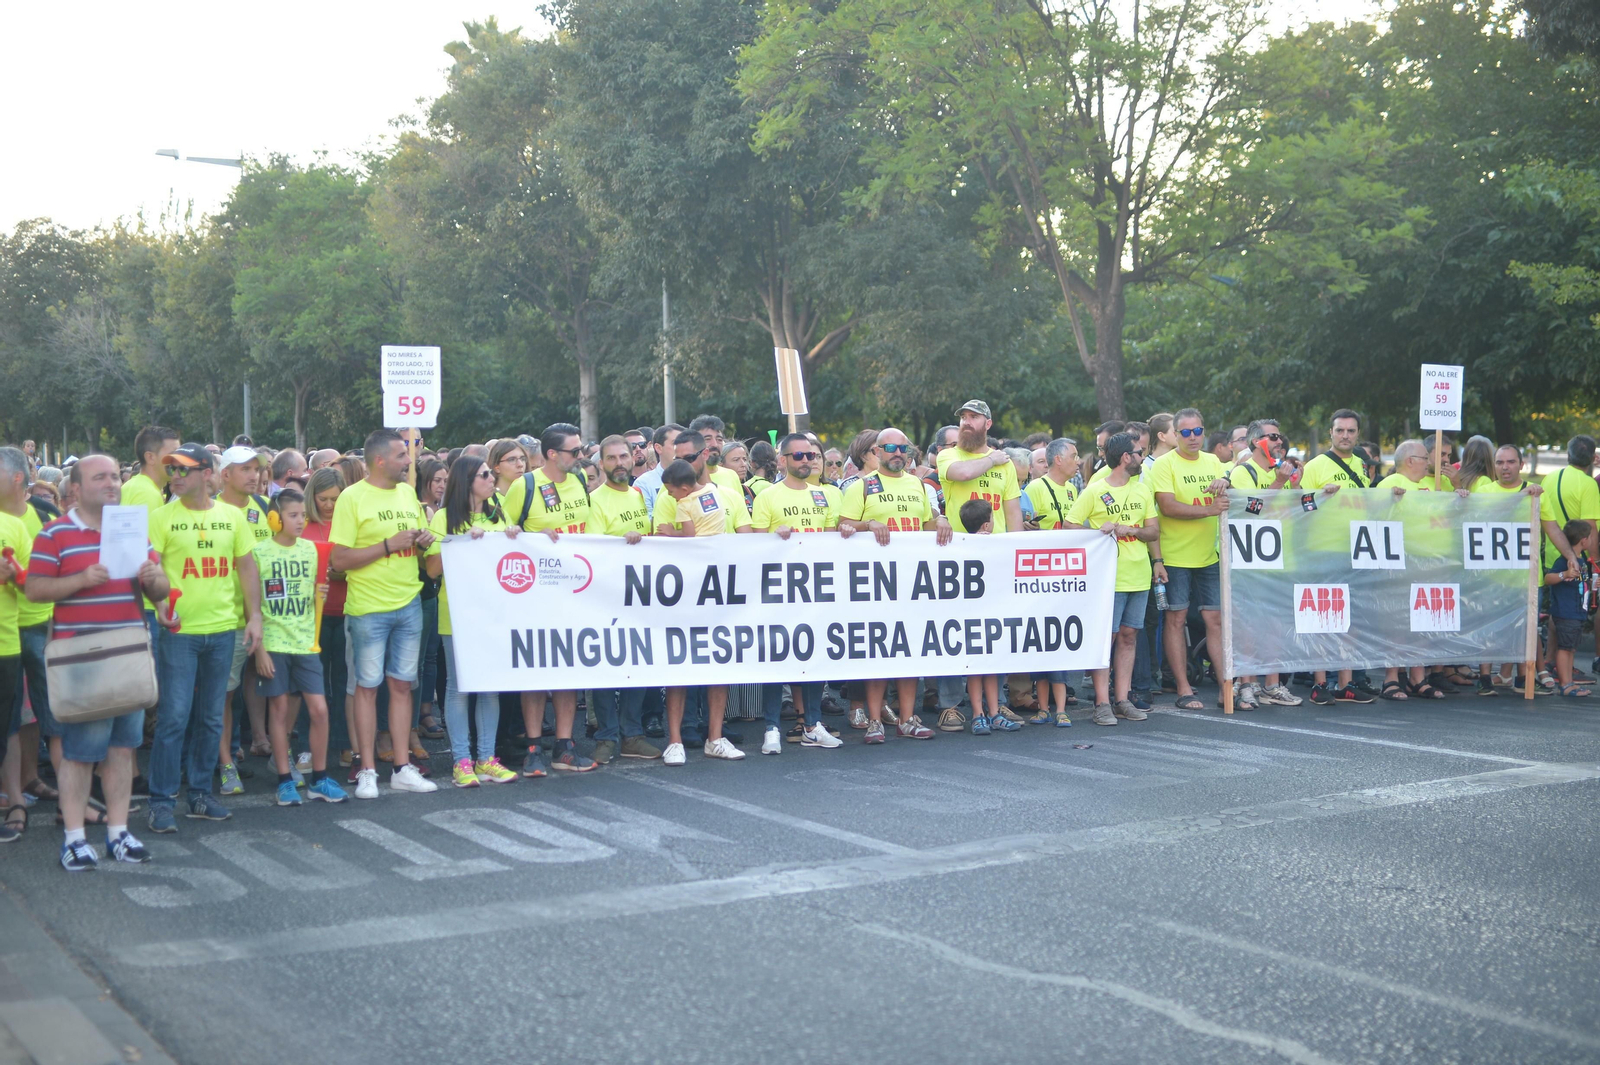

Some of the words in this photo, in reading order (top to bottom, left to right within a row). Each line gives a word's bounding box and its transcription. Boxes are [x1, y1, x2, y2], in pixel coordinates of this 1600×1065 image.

[1434, 382, 1450, 390] ABB
[1436, 394, 1448, 404] 59
[398, 396, 426, 416] 59
[1424, 409, 1457, 418] DESPIDOS
[990, 472, 1002, 480] ERE
[1183, 474, 1196, 484] NO
[1334, 472, 1346, 481] NO
[878, 493, 894, 503] NO
[564, 502, 572, 510] AL
[574, 498, 586, 508] ERE
[378, 510, 394, 521] NO
[396, 511, 406, 519] AL
[783, 506, 799, 517] NO
[812, 507, 824, 515] ERE
[1106, 504, 1120, 516] NO
[564, 512, 575, 520] EN
[620, 510, 632, 522] NO
[634, 510, 641, 518] AL
[171, 523, 188, 531] NO
[211, 522, 232, 530] ERE
[397, 523, 408, 531] EN
[636, 521, 644, 530] EN
[887, 517, 920, 531] ABB
[255, 529, 268, 538] ERE
[197, 540, 213, 549] EN
[1228, 524, 1282, 563] NO
[1352, 526, 1400, 561] AL
[1468, 527, 1531, 561] ERE
[501, 558, 530, 574] UGT
[539, 558, 562, 568] FICA
[1018, 552, 1083, 571] CCOO
[181, 556, 229, 579] ABB
[272, 560, 310, 578] RIDE
[624, 564, 684, 607] NO
[696, 564, 746, 605] AL
[761, 561, 836, 604] ERE
[848, 561, 898, 602] EN
[911, 560, 986, 601] ABB
[1014, 577, 1086, 594] industria
[1299, 588, 1346, 618] ABB
[1414, 587, 1455, 617] ABB
[510, 618, 654, 668] NINGÚN
[666, 623, 815, 665] DESPIDO
[826, 620, 912, 661] SERA
[920, 614, 1083, 657] ACEPTADO
